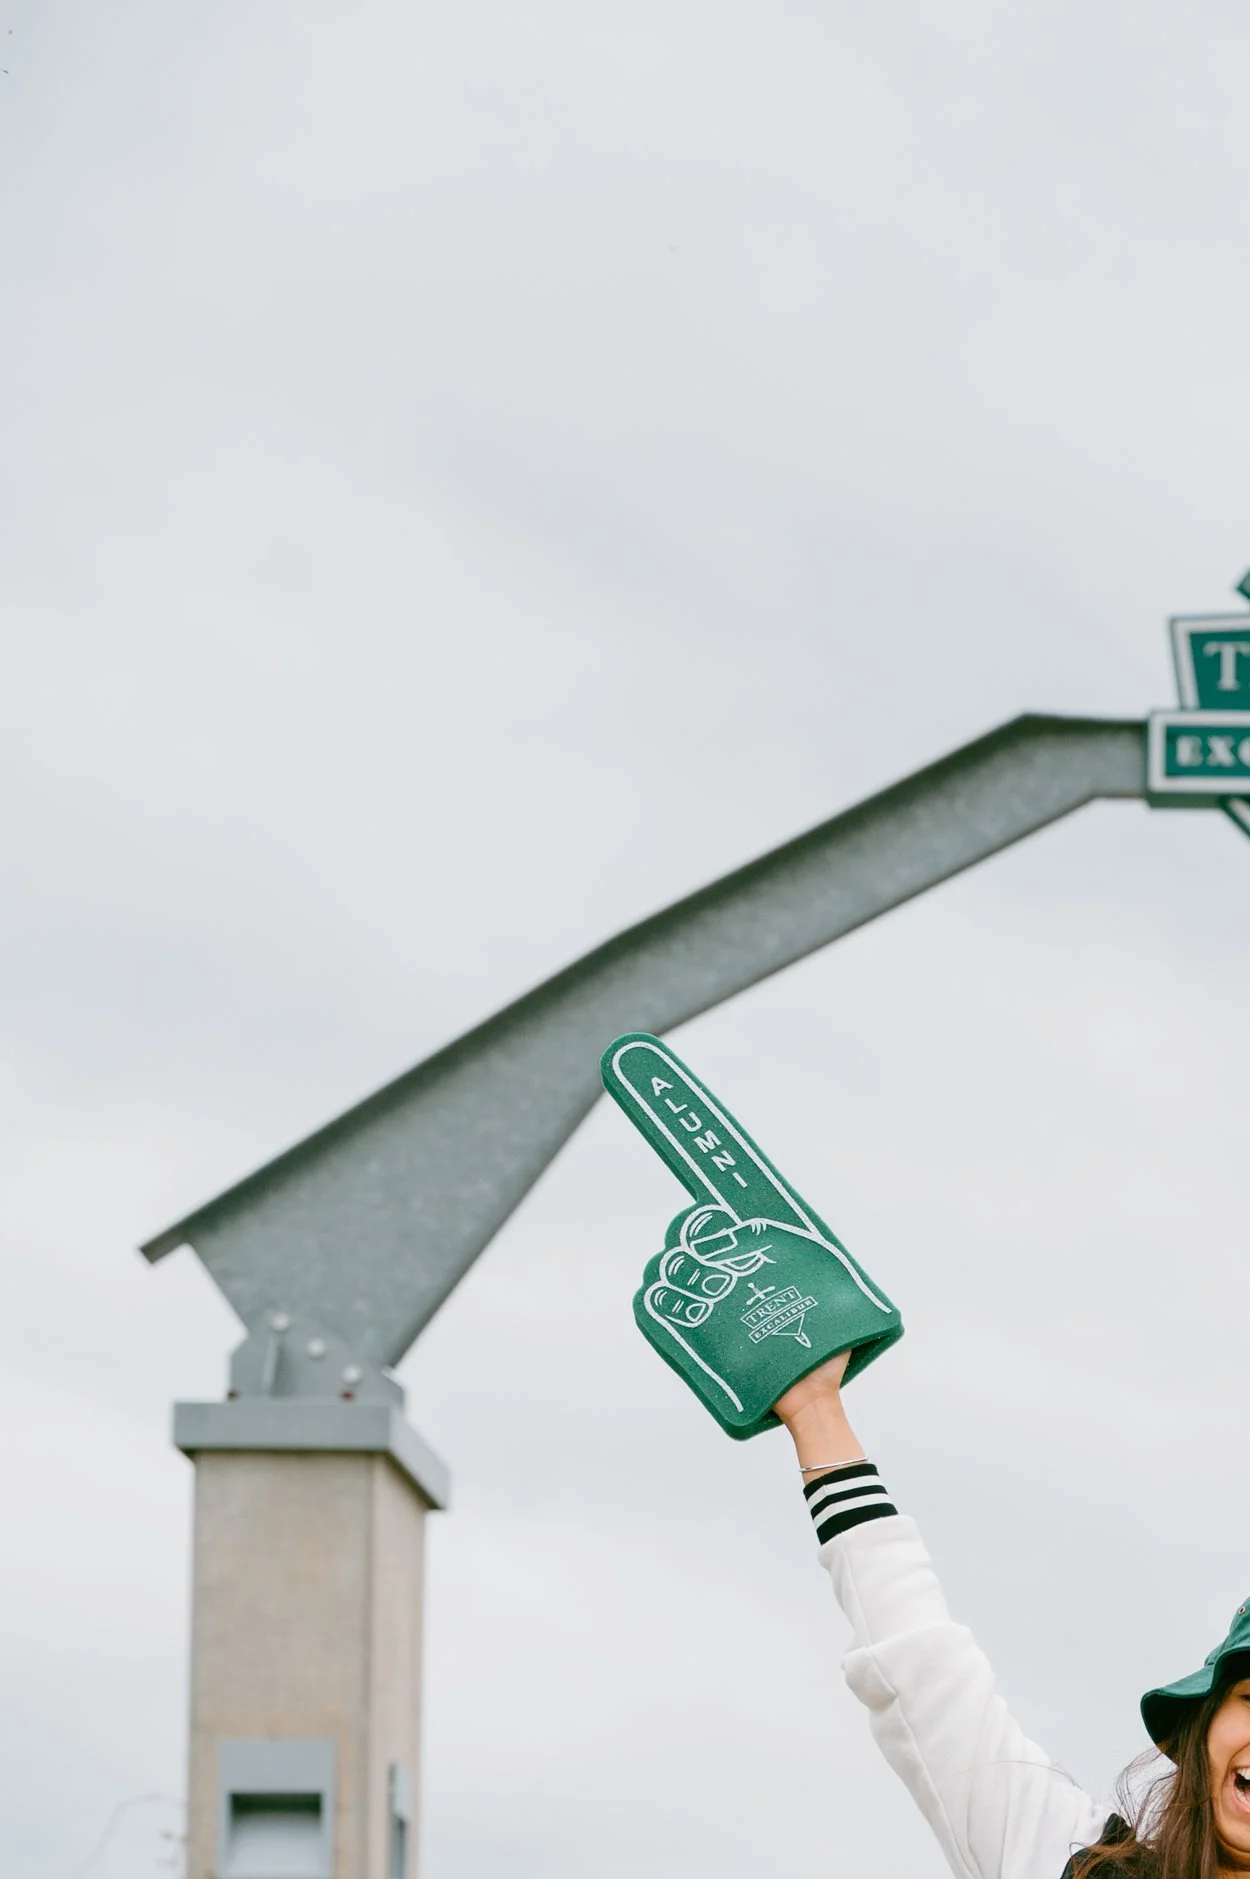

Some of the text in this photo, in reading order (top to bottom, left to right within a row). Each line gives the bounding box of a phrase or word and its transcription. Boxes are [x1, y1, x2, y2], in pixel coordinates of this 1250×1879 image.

[651, 1076, 748, 1189] ALUMNI
[746, 1290, 796, 1323] TRENT
[754, 1300, 813, 1338] EXCALIBUR
